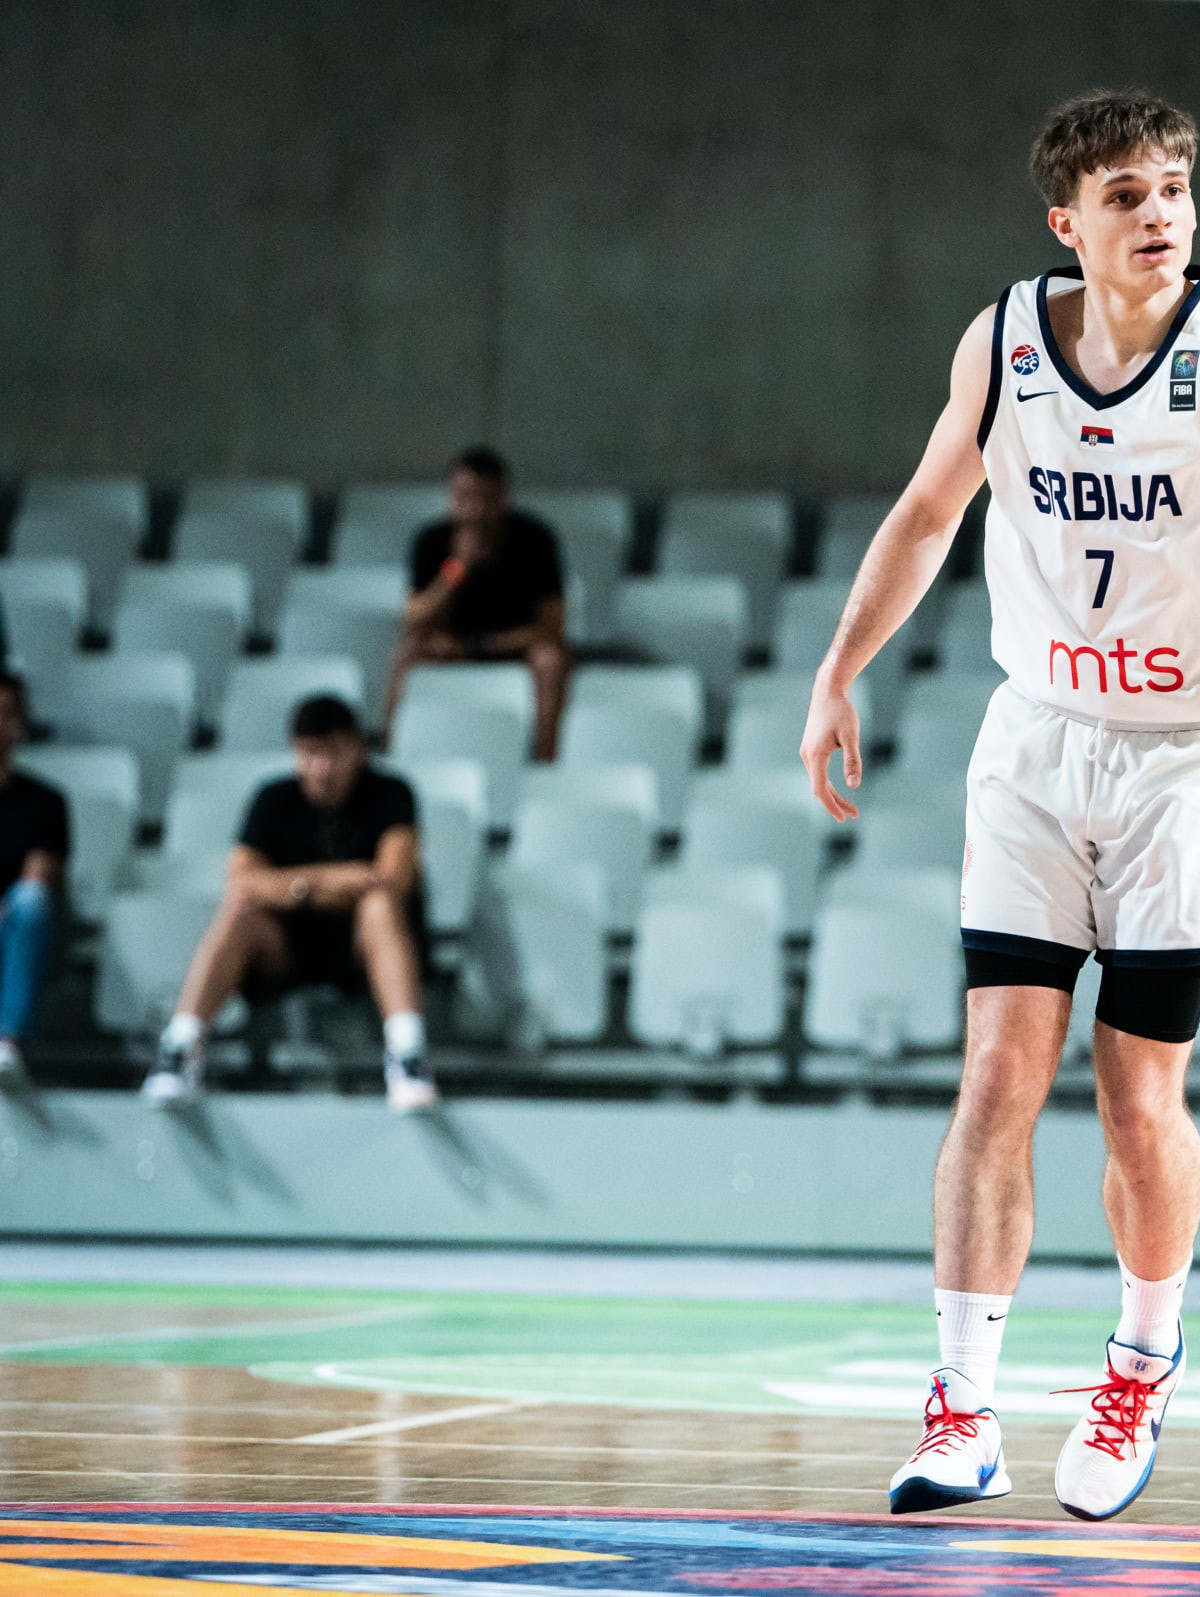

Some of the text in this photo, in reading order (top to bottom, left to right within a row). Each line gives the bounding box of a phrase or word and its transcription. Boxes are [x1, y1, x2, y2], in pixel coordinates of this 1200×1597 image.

[1173, 384, 1193, 396] FIBA
[1029, 465, 1182, 522] SRBIJA
[1085, 549, 1115, 609] 7
[1049, 637, 1185, 693] mts
